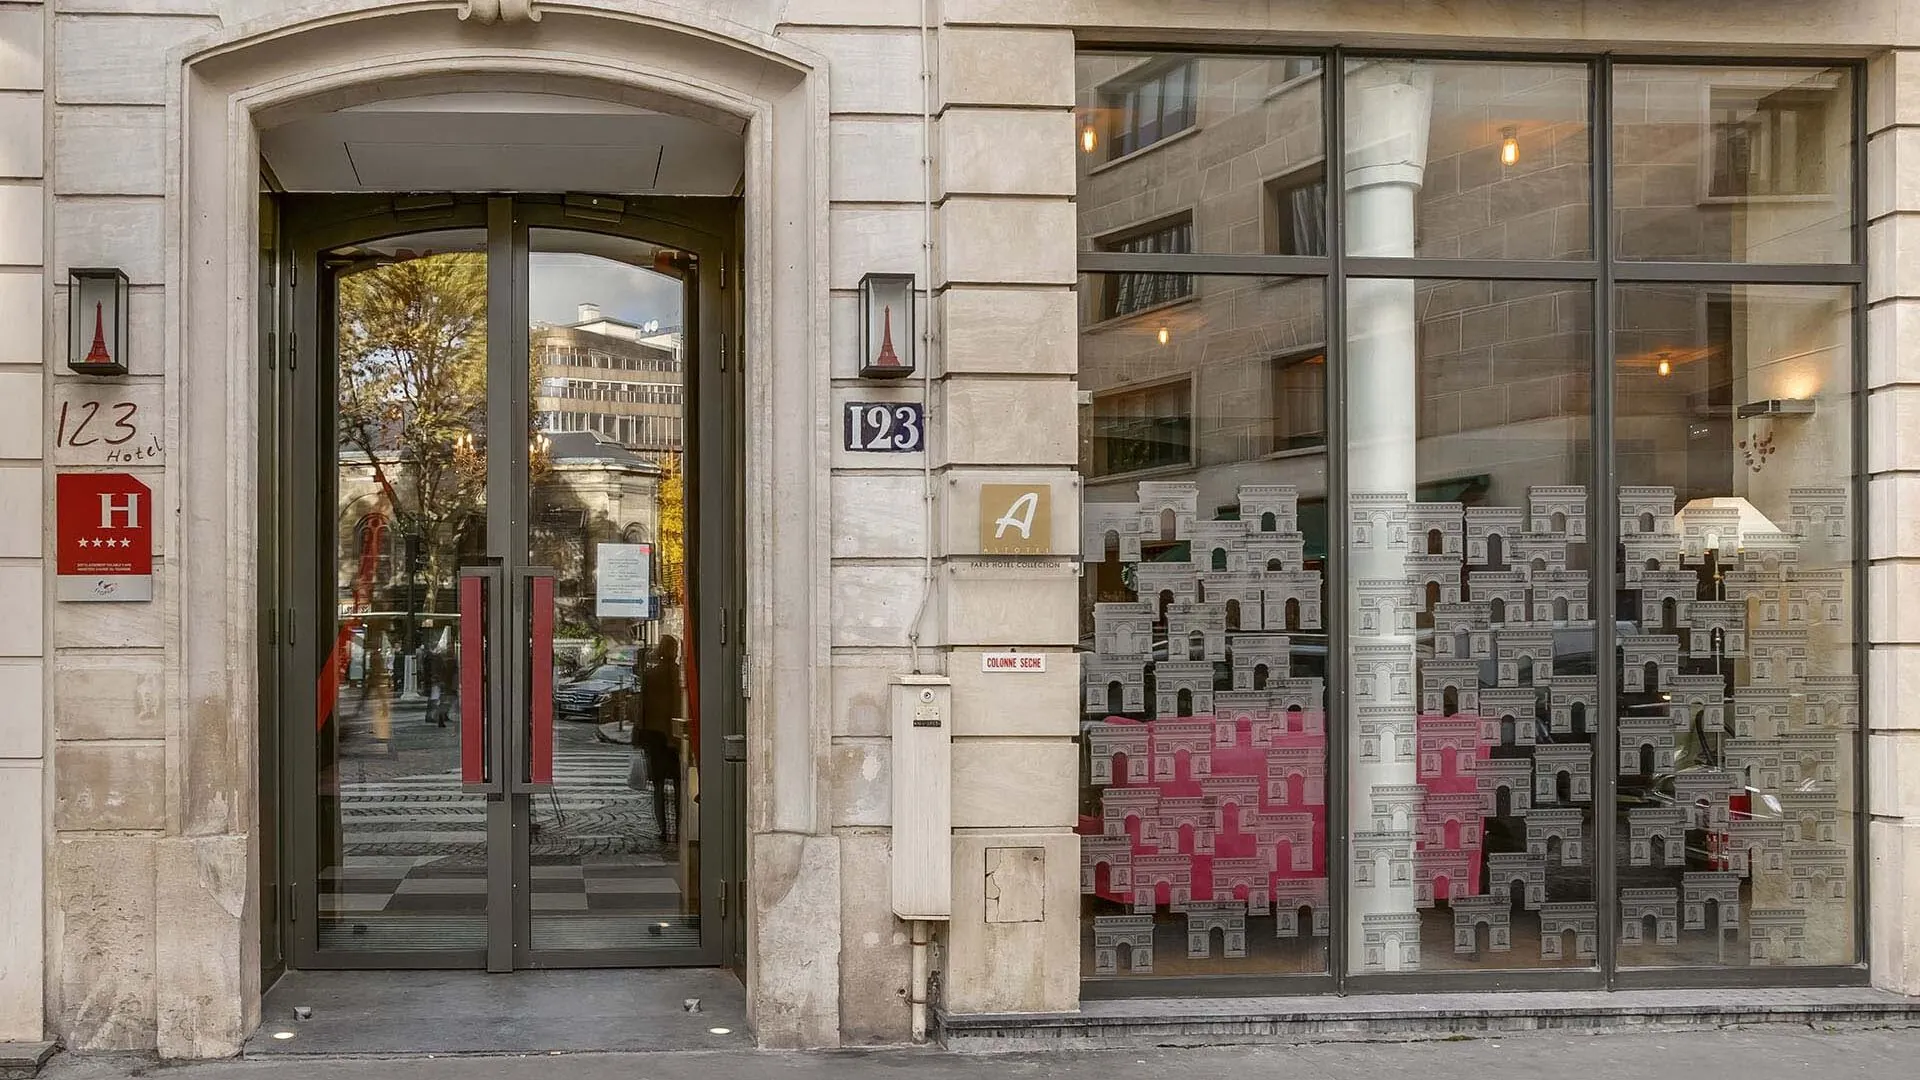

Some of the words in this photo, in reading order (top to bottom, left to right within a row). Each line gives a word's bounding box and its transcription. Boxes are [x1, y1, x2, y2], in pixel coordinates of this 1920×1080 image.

[57, 401, 137, 448] 123
[849, 405, 920, 450] 123
[107, 436, 162, 462] Hotel
[97, 493, 142, 529] H
[994, 492, 1039, 540] A
[970, 561, 991, 569] PARIS
[993, 561, 1015, 569] HOTEL
[1017, 561, 1061, 569] COLLECTION
[987, 657, 1017, 668] COLONNE
[1020, 657, 1041, 668] SECHE
